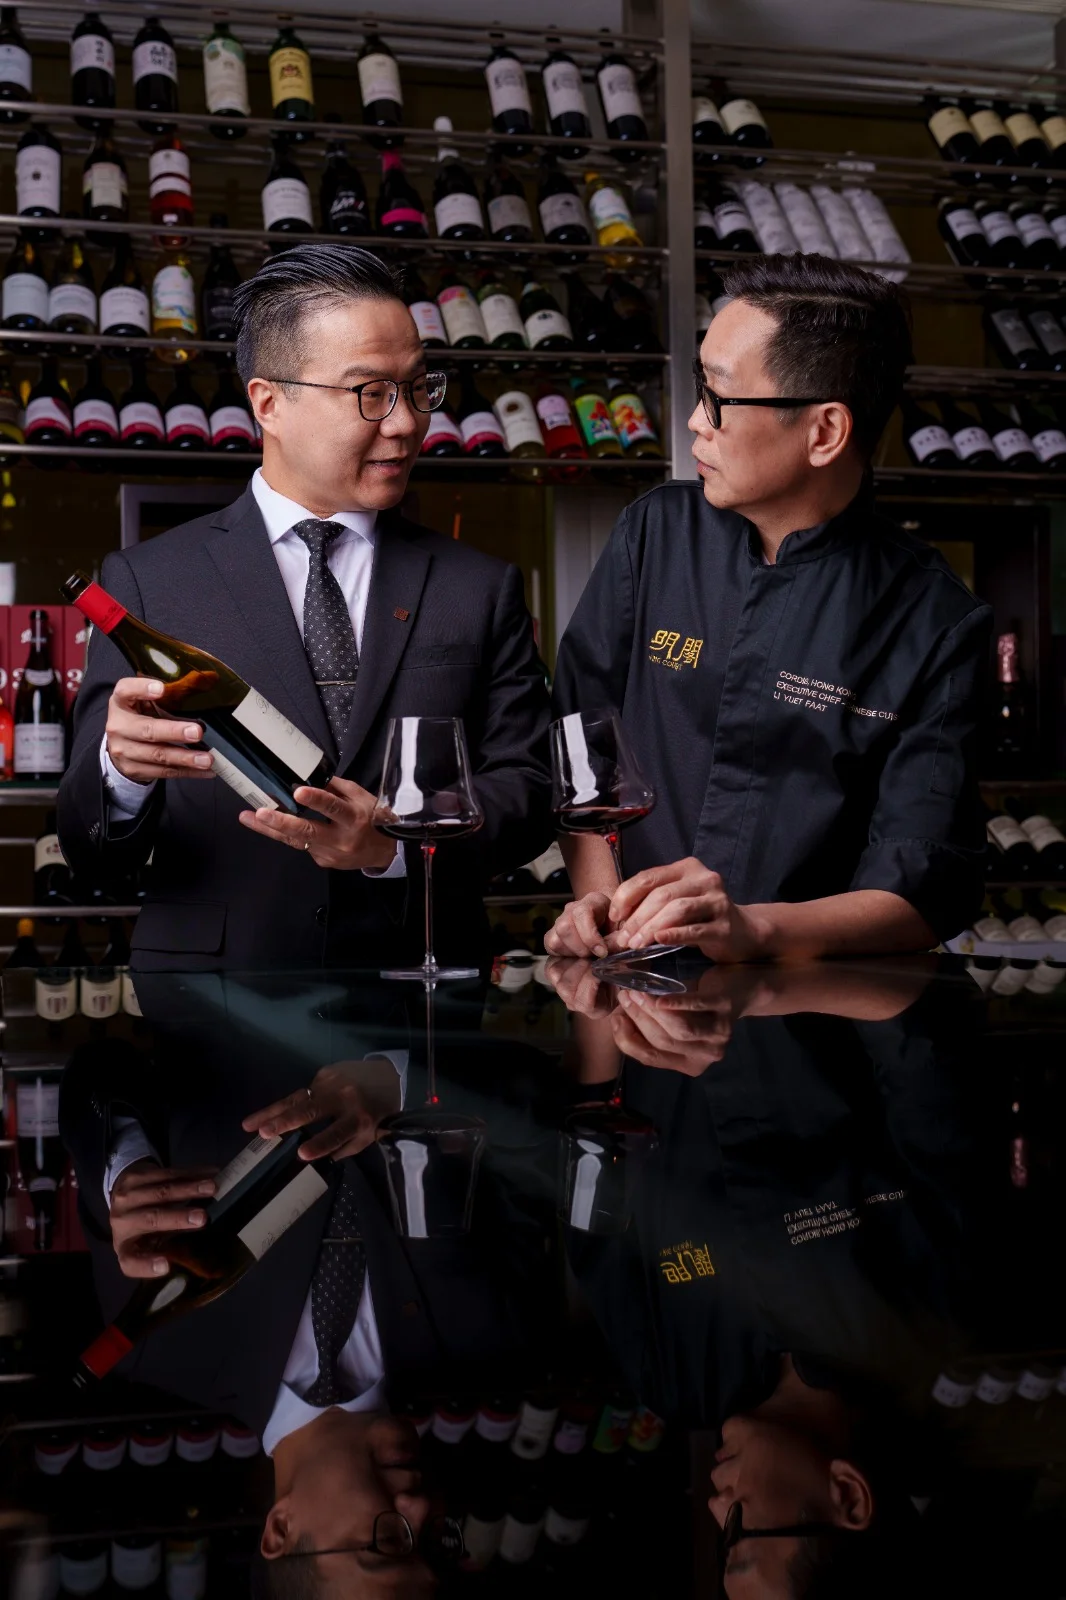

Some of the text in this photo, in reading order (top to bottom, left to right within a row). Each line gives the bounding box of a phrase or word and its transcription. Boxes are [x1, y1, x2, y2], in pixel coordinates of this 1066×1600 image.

[779, 670, 810, 686] CORDIS,
[810, 678, 835, 692] HONG
[773, 691, 828, 712] LI YUET FAAT
[776, 680, 818, 698] EXECUTIVE
[818, 691, 841, 705] CHEF
